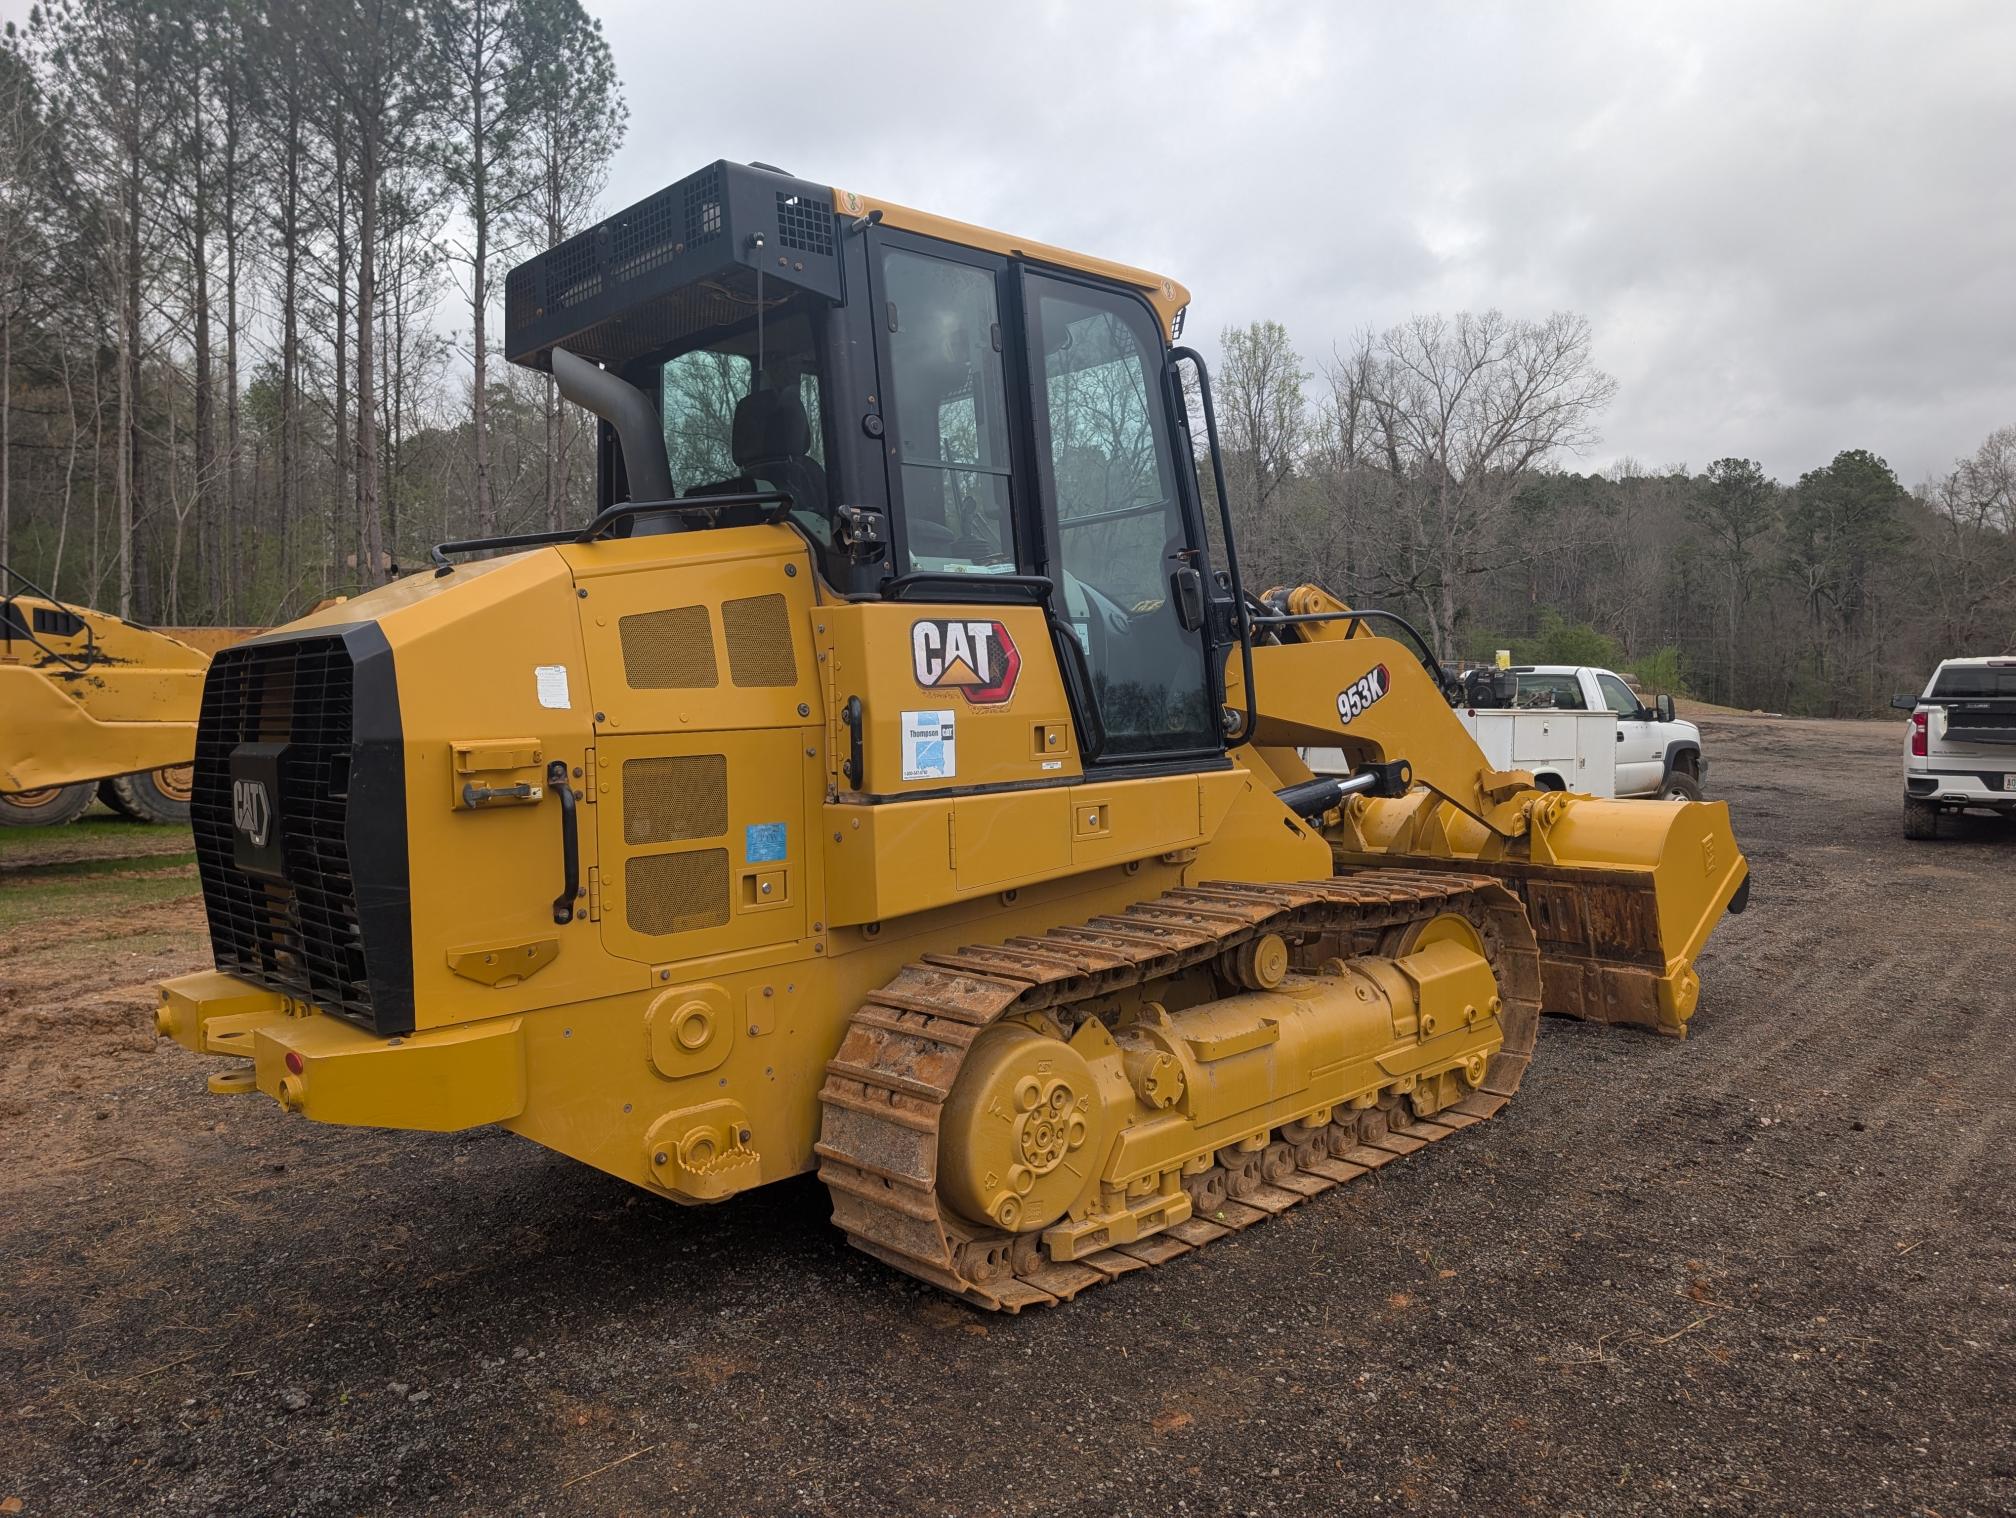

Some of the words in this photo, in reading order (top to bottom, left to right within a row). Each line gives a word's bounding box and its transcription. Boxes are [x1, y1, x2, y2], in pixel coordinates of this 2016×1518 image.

[913, 621, 993, 686] CAT
[1337, 668, 1384, 723] 953K
[910, 729, 939, 738] Thompson
[234, 781, 258, 831] CAT
